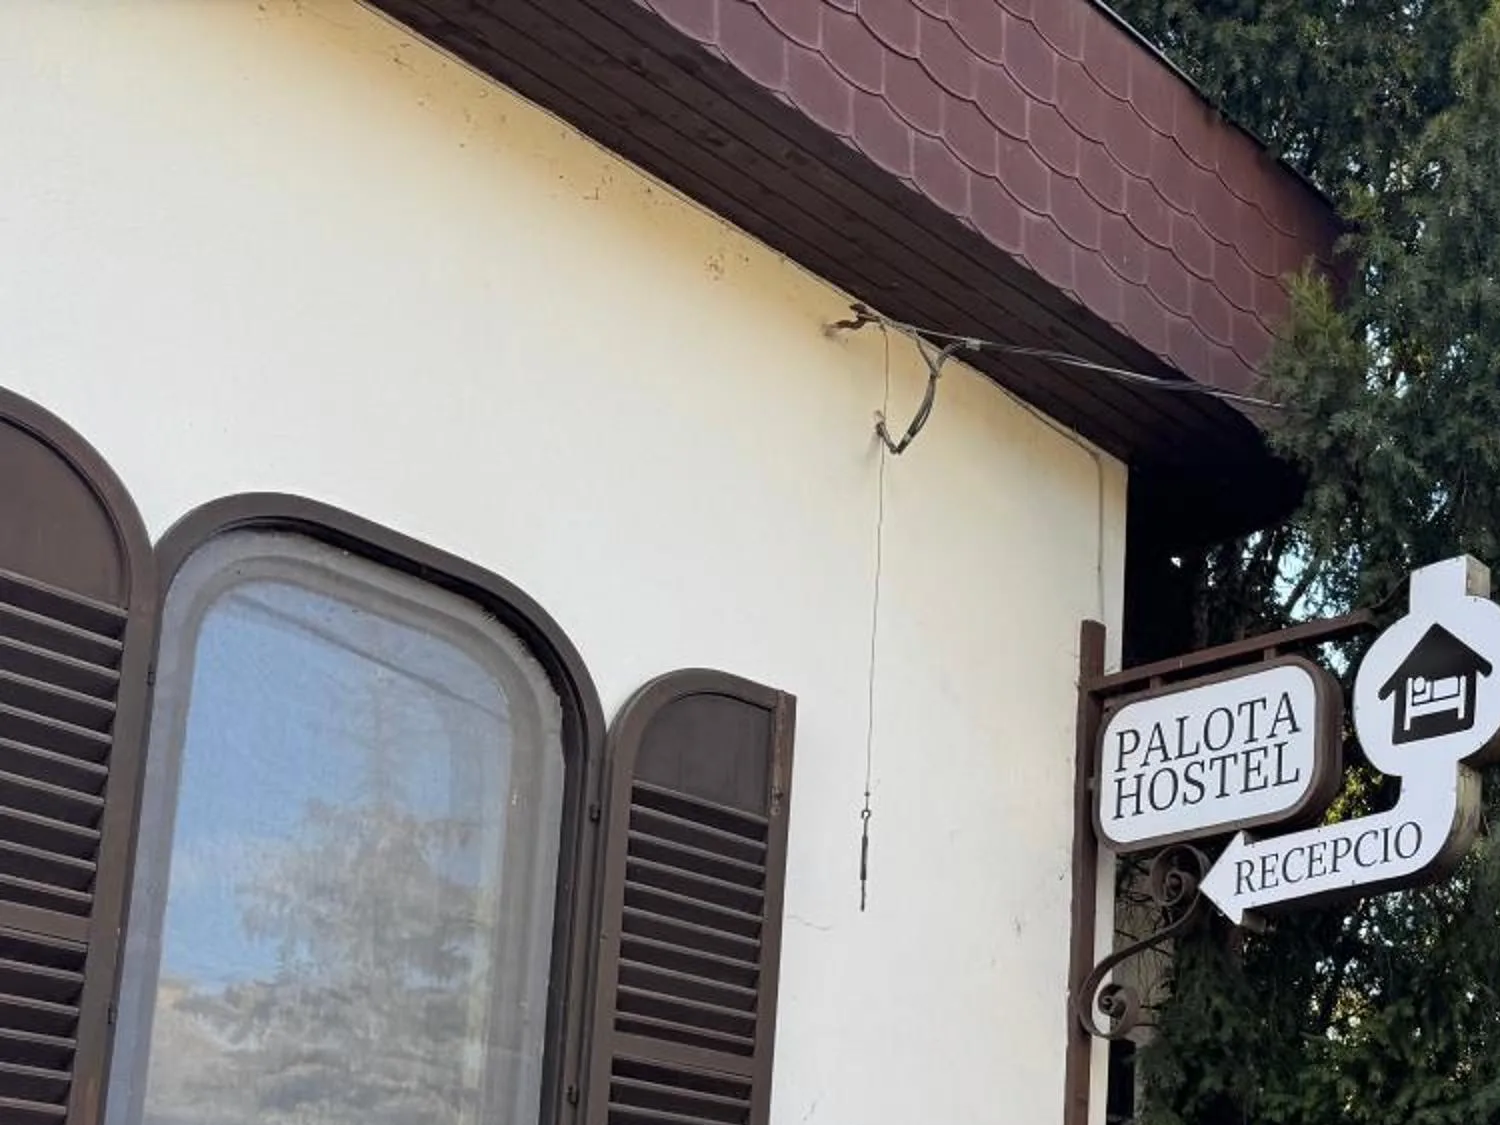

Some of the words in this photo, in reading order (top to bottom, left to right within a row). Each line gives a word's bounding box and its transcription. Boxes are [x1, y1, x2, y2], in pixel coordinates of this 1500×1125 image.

[1114, 691, 1301, 772] PALOTA
[1113, 741, 1300, 820] HOSTEL
[1234, 821, 1422, 896] RECEPCIO
